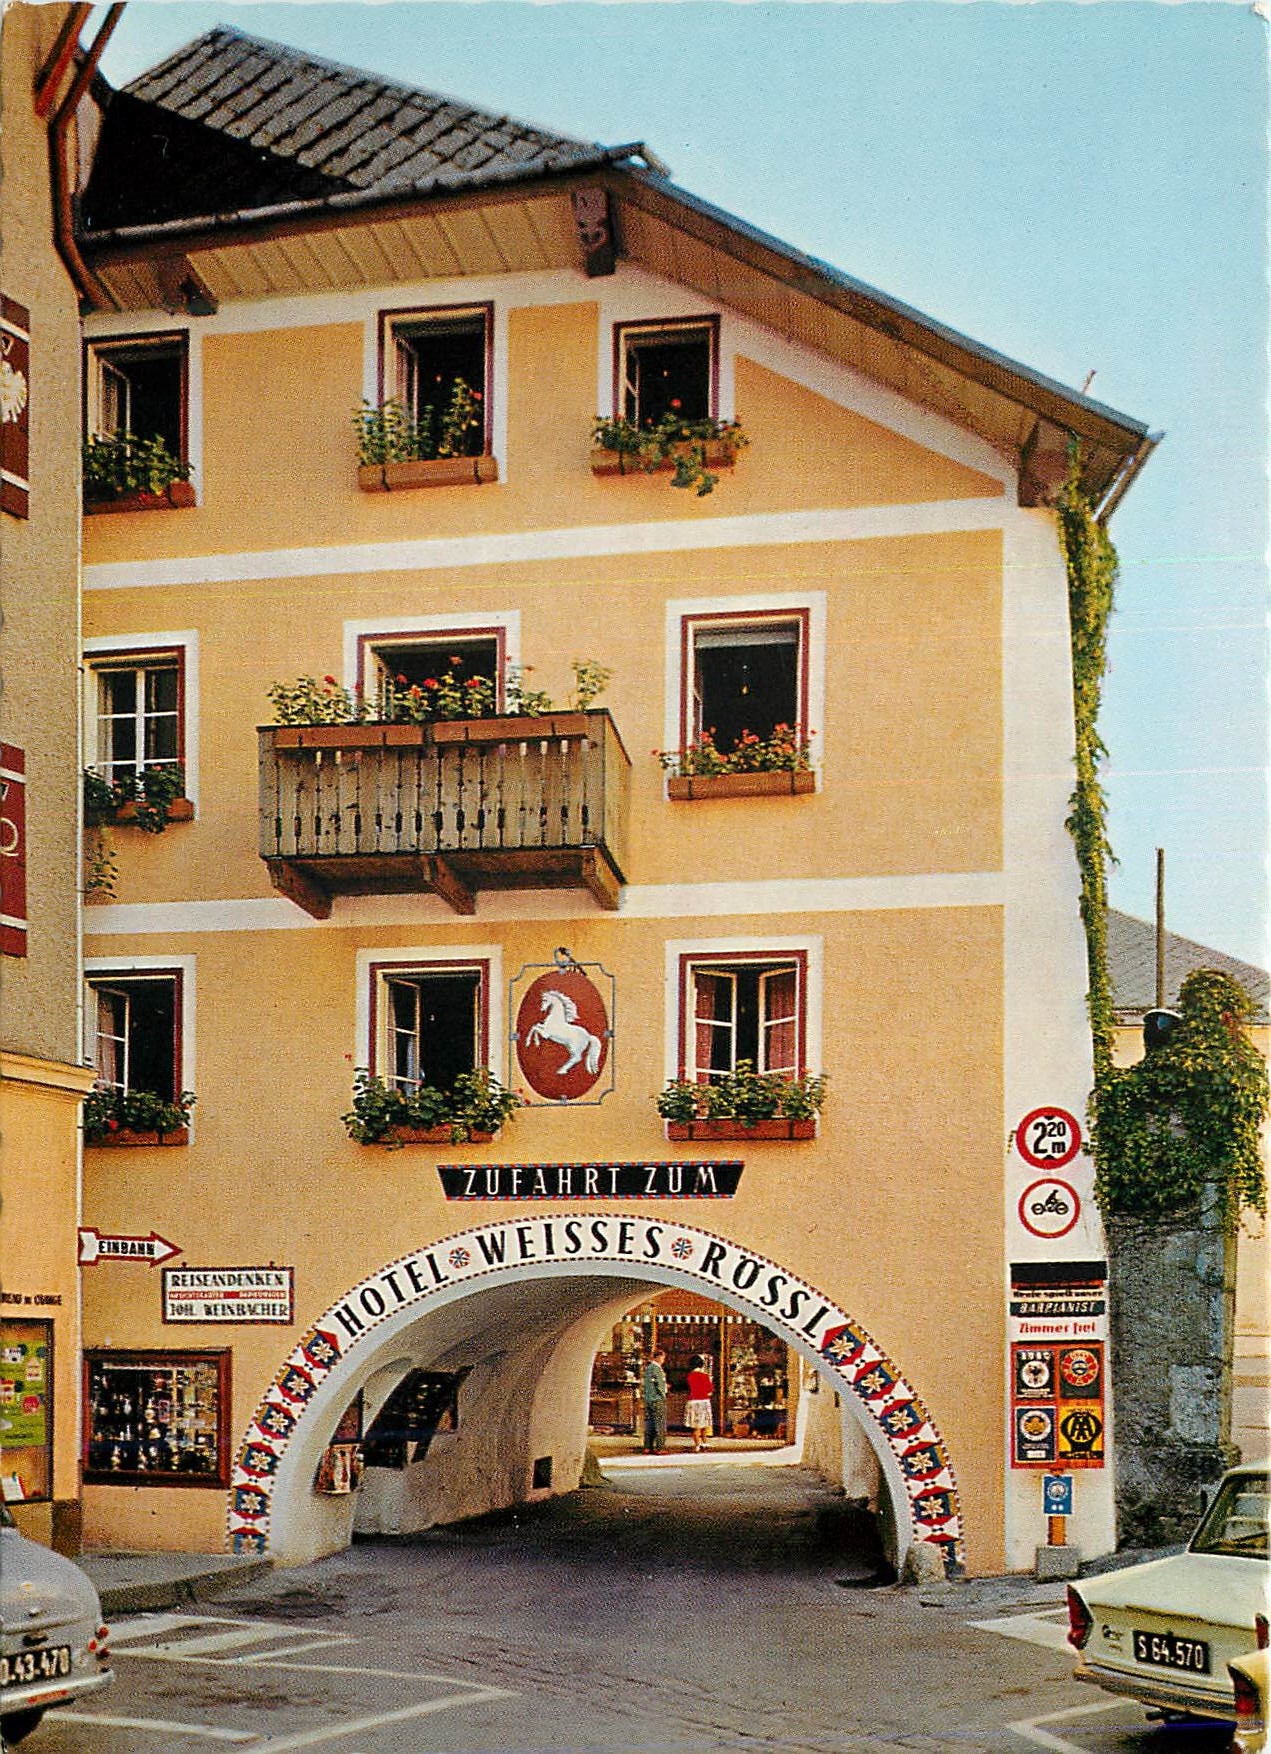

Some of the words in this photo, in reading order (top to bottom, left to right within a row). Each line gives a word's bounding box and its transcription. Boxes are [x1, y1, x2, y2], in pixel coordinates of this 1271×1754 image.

[464, 1167, 620, 1196] ZUFAHRT
[645, 1166, 718, 1194] ZUM
[98, 1239, 155, 1256] EINBAHN
[171, 1273, 284, 1287] REISEANDENKEN
[333, 1253, 449, 1337] HOTEL
[476, 1221, 664, 1266] WEISSES
[699, 1241, 830, 1338] RÖSSL
[1019, 1322, 1069, 1334] Zimmer
[1137, 1635, 1147, 1658] S
